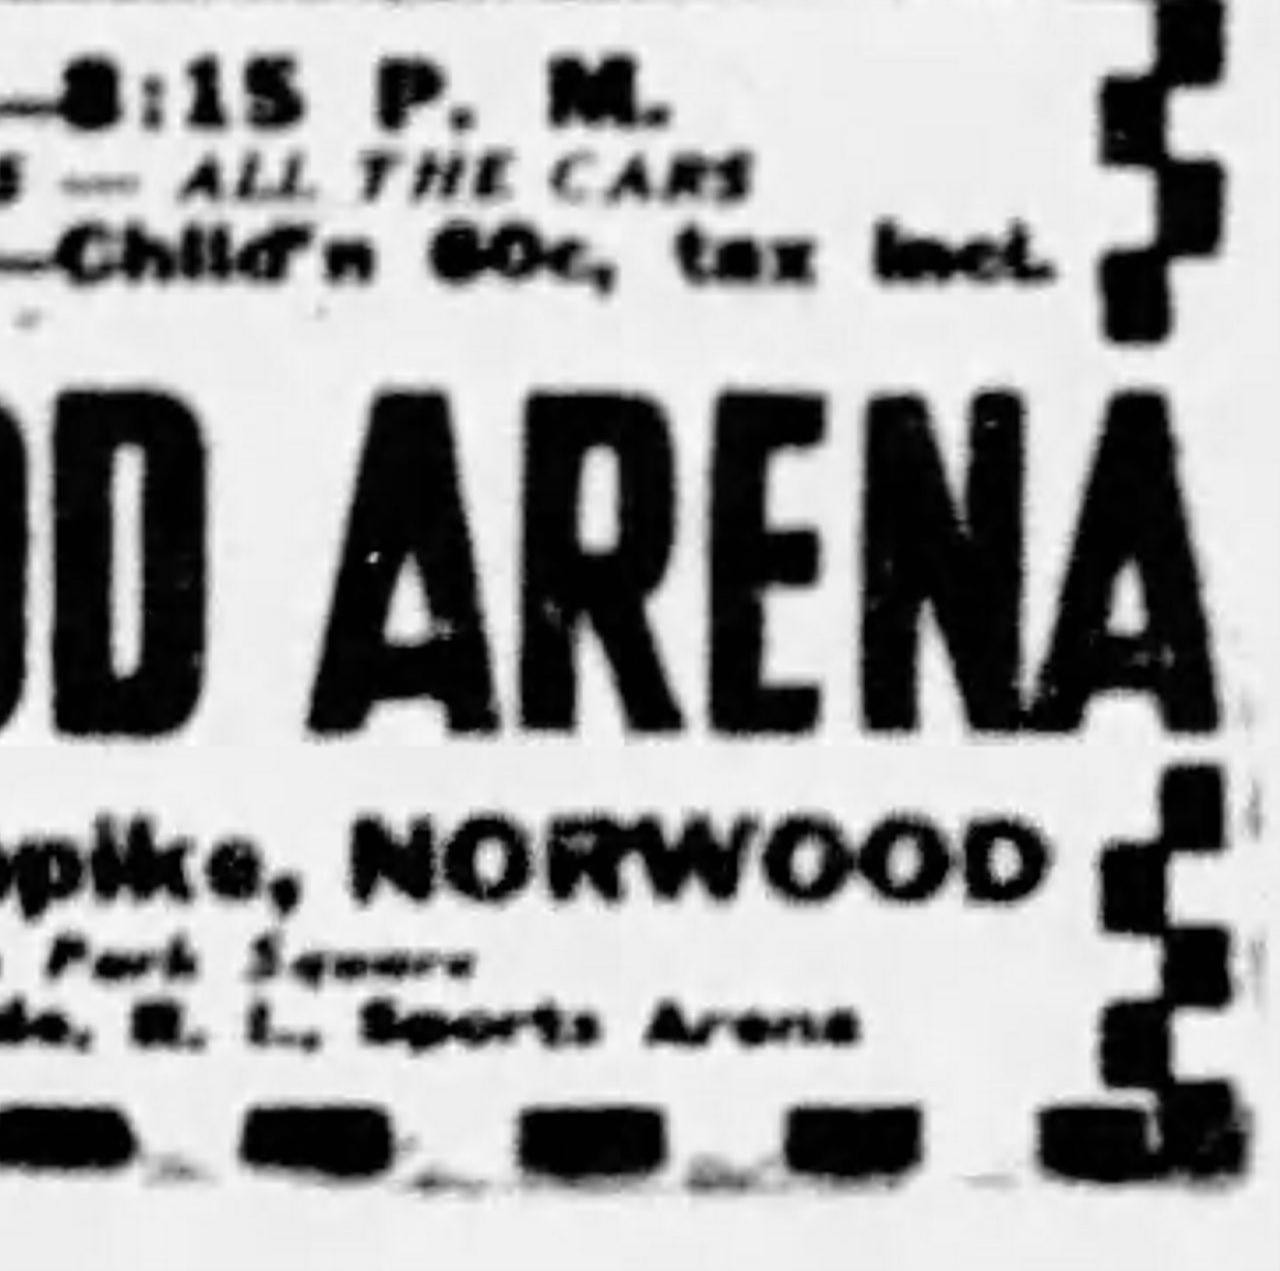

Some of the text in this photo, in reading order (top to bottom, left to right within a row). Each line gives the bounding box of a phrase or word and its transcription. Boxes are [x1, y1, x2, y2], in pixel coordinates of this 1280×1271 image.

[375, 56, 475, 133] P.
[545, 53, 672, 130] M.
[178, 152, 314, 203] ALL
[361, 149, 513, 203] THE
[548, 150, 754, 204] CARS
[673, 223, 816, 286] tax
[304, 387, 1224, 739] ARENA
[347, 812, 1054, 907] NORWOOD
[43, 933, 200, 983] Park
[642, 999, 863, 1050] Arena
